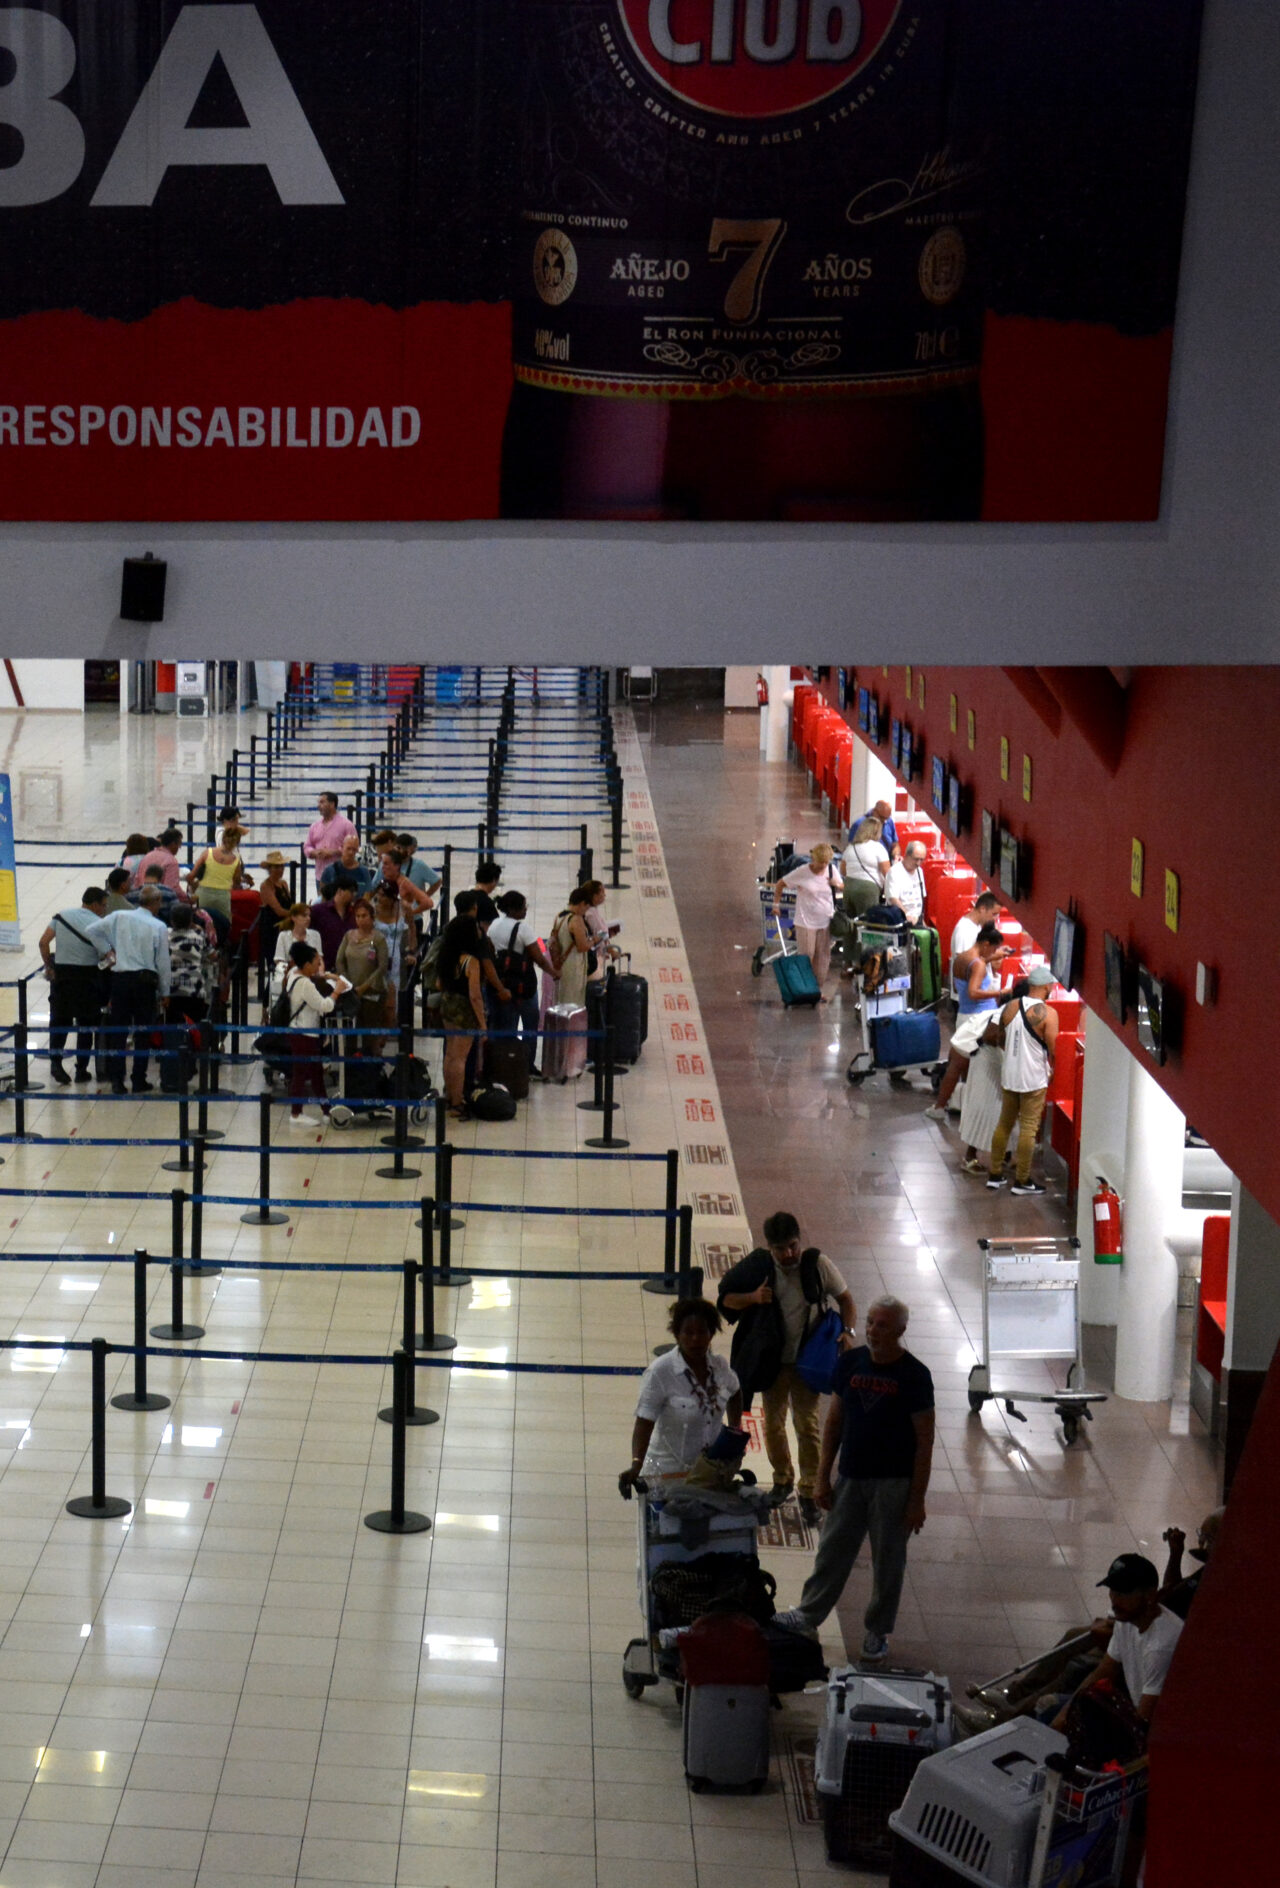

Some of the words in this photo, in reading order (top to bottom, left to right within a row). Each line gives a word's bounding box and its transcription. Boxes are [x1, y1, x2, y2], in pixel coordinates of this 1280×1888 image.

[599, 22, 636, 89] CREATED
[644, 98, 706, 140] CRAFTED
[716, 133, 749, 145] AND
[760, 128, 803, 145] AGED
[829, 86, 876, 124] YEARS
[879, 64, 895, 80] IN
[895, 17, 921, 58] CUBA
[568, 214, 629, 230] CONTINUO
[609, 252, 690, 281] AÑEJO
[707, 217, 788, 327] 7
[801, 253, 873, 281] AÑOS
[627, 285, 665, 298] AGED
[812, 285, 861, 299] YEARS
[849, 1374, 899, 1396] GUESS
